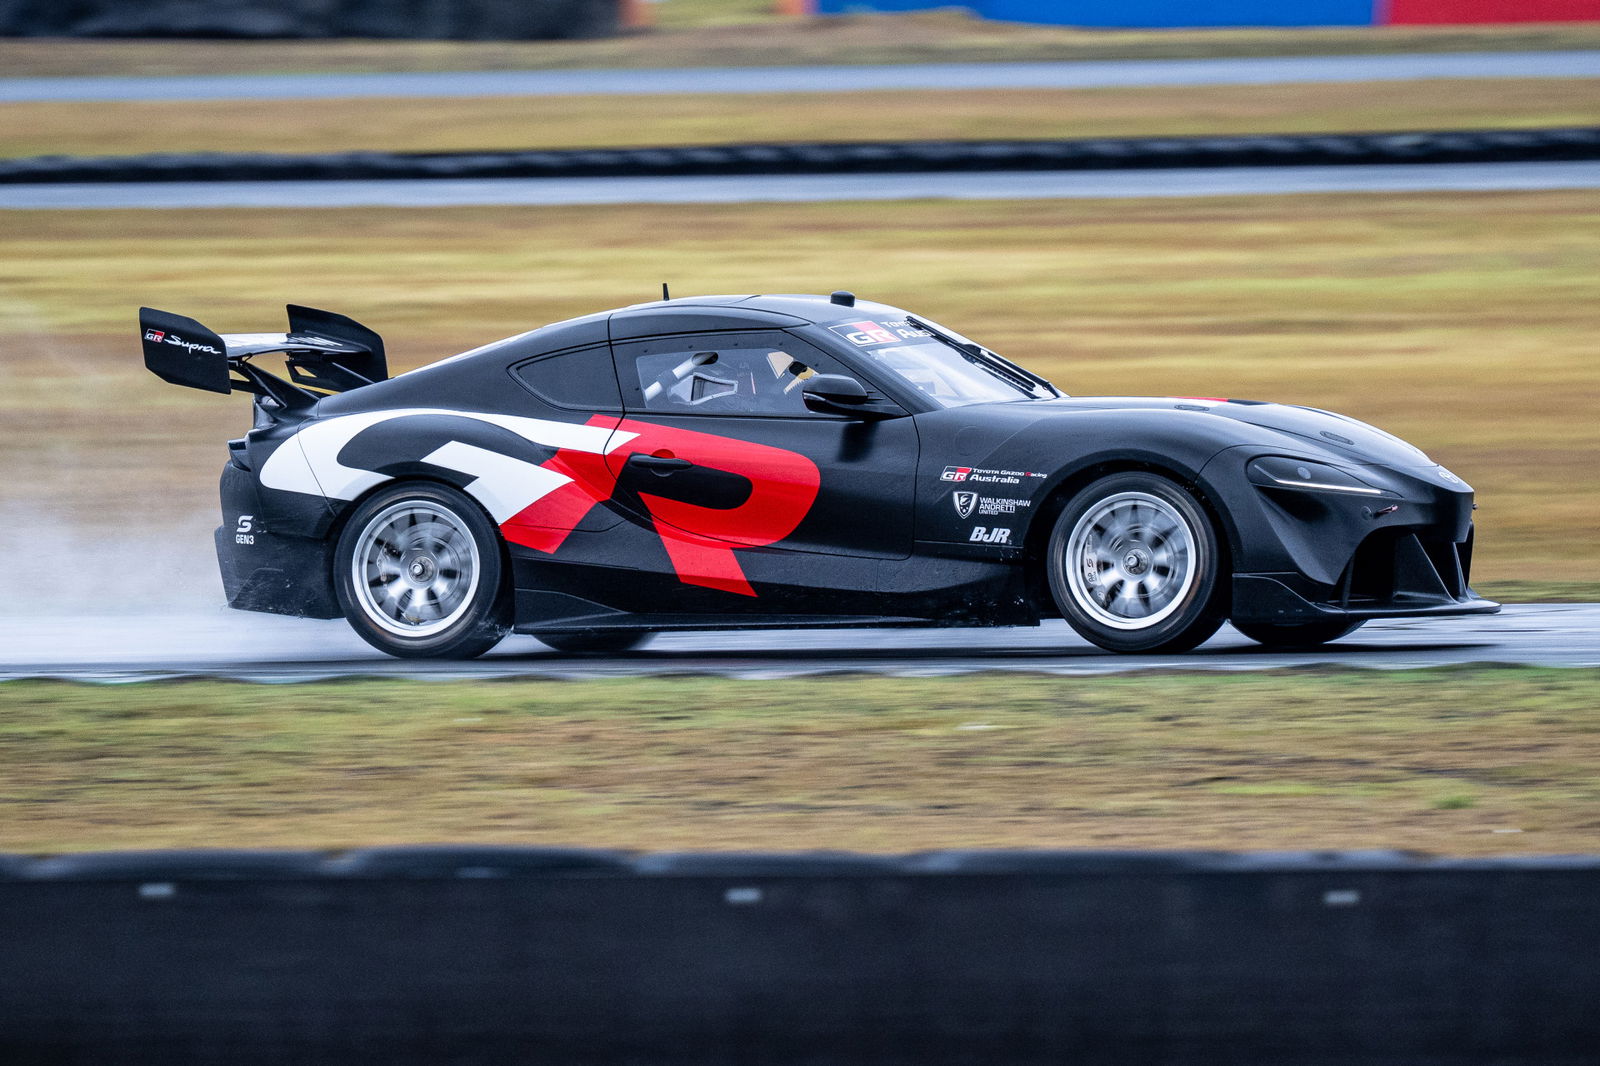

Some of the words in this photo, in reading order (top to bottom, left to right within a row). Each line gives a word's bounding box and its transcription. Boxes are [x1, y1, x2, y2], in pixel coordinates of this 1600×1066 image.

[846, 327, 900, 345] GR
[145, 332, 164, 343] GR
[164, 334, 222, 354] Supra
[941, 471, 968, 482] GR
[969, 474, 1020, 484] Australia
[1025, 471, 1048, 479] Racing
[979, 496, 1031, 508] WALKINSHAW
[979, 503, 1016, 512] ANDRETTI
[235, 534, 255, 545] GEN3
[969, 526, 1011, 544] BJR
